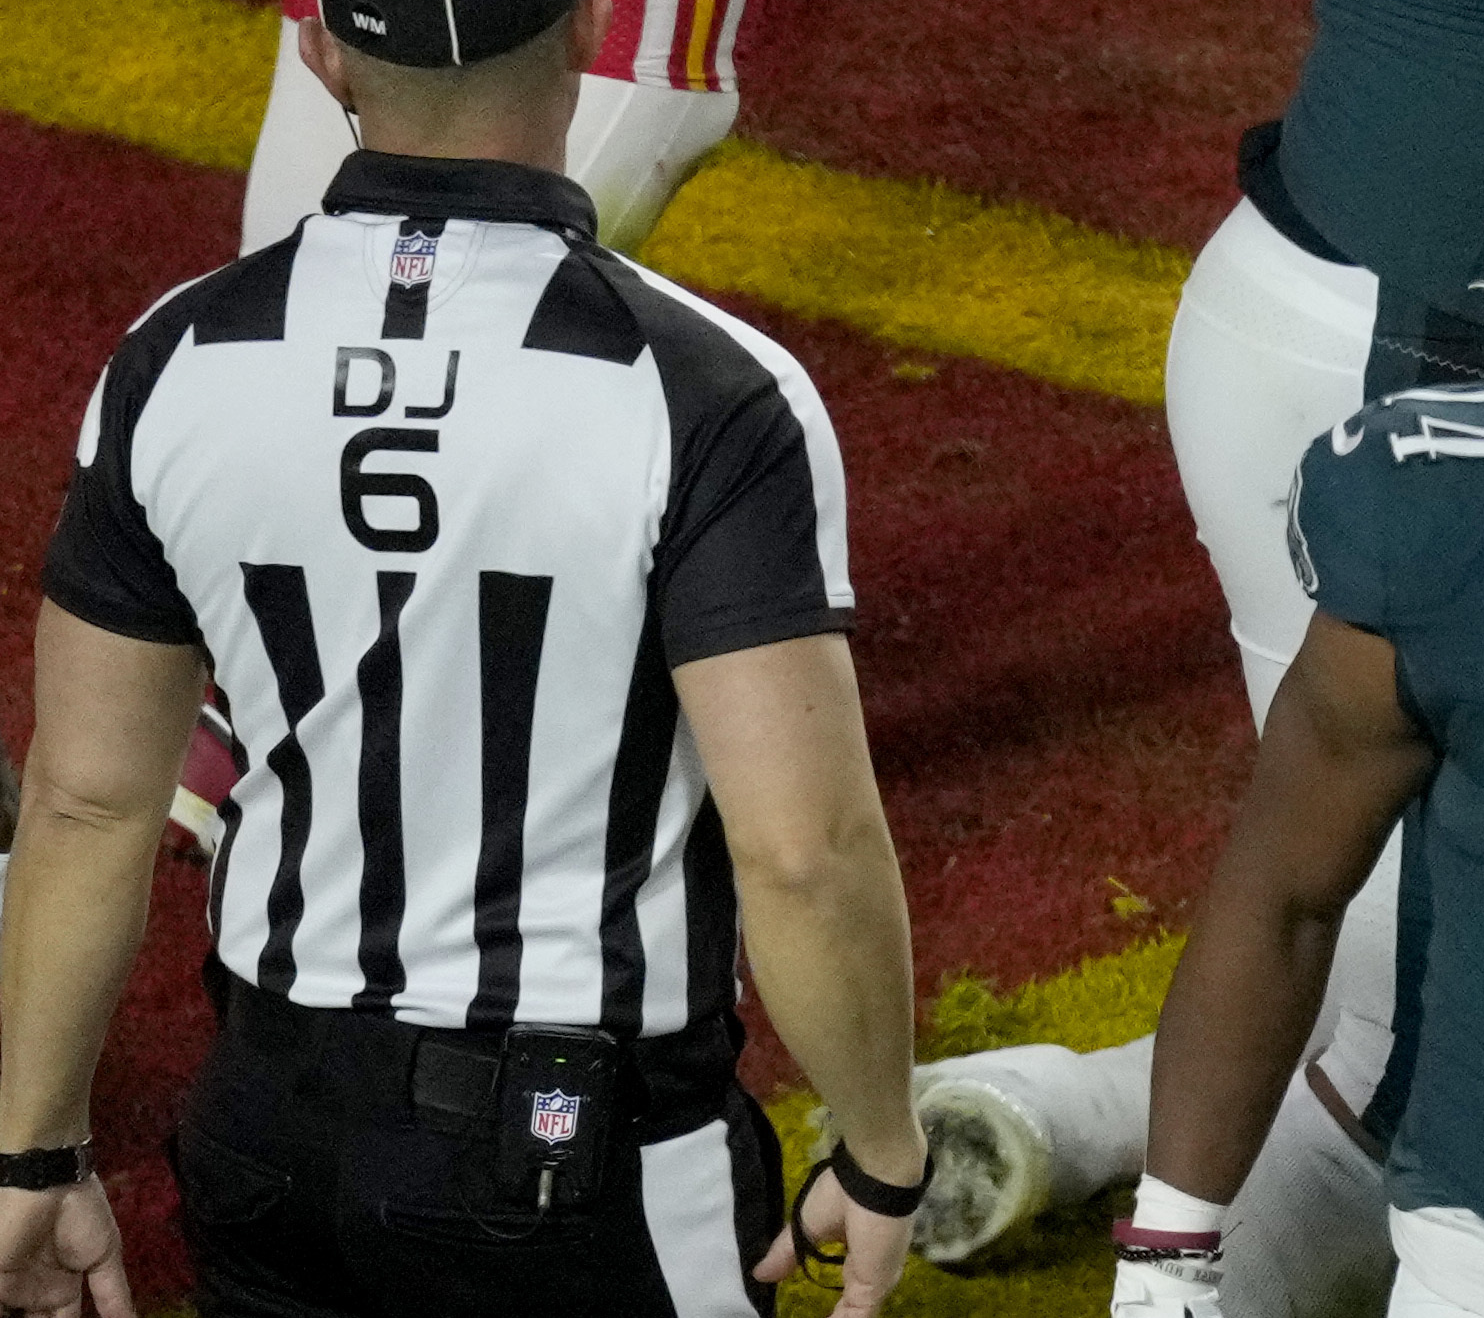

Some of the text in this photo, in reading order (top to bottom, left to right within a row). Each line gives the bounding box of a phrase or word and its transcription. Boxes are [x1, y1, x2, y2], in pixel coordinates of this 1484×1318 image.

[351, 11, 387, 36] WM
[393, 255, 430, 280] NFL
[332, 346, 461, 419] DJ
[339, 427, 441, 554] 6
[536, 1112, 570, 1137] NFL
